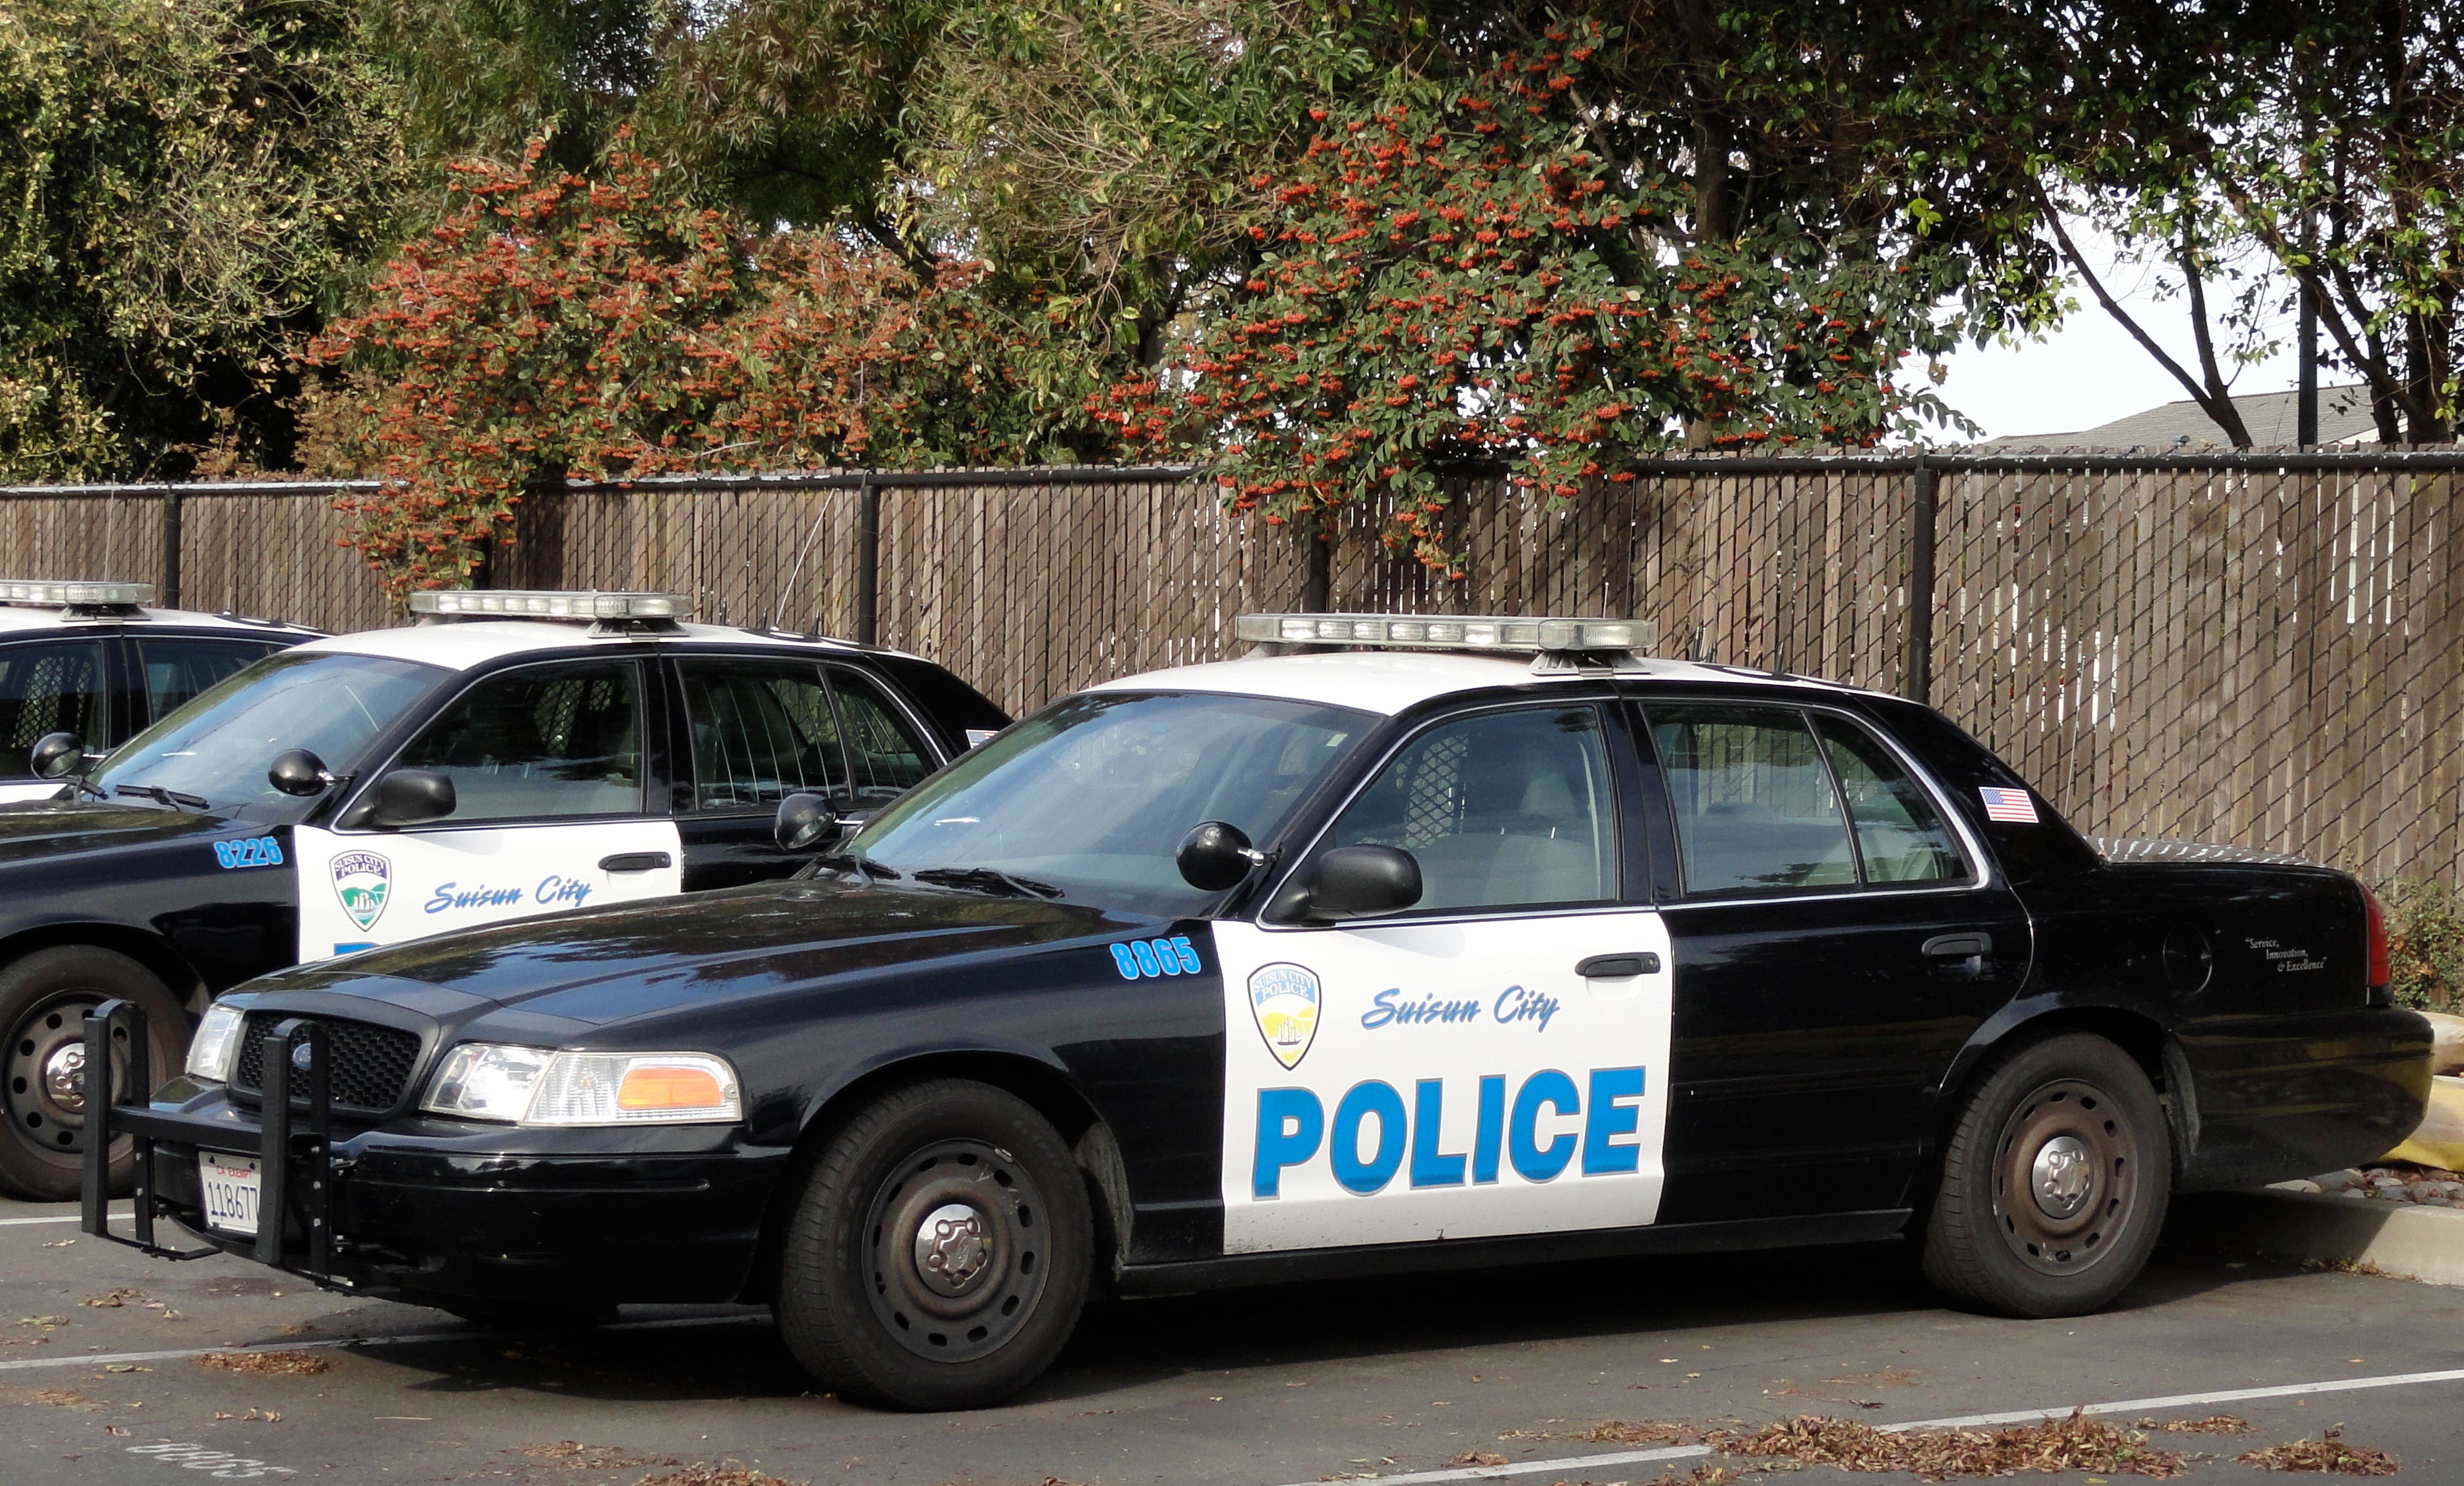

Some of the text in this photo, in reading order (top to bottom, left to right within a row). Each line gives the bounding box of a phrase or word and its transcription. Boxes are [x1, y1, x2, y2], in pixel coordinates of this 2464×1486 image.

[213, 836, 283, 869] 8226
[335, 855, 385, 871] SUISUN CITY
[341, 863, 382, 877] POLICE
[424, 875, 592, 913] Suisun City
[1110, 936, 1201, 980] 8865
[2278, 962, 2285, 972] &
[1254, 971, 1312, 993] SUISUN CITY
[1261, 982, 1308, 1001] POLICE
[1361, 985, 1561, 1033] Suisun City
[1251, 1066, 1646, 1201] POLICE
[217, 1165, 252, 1179] CA EXEMPT
[207, 1181, 258, 1221] 118677
